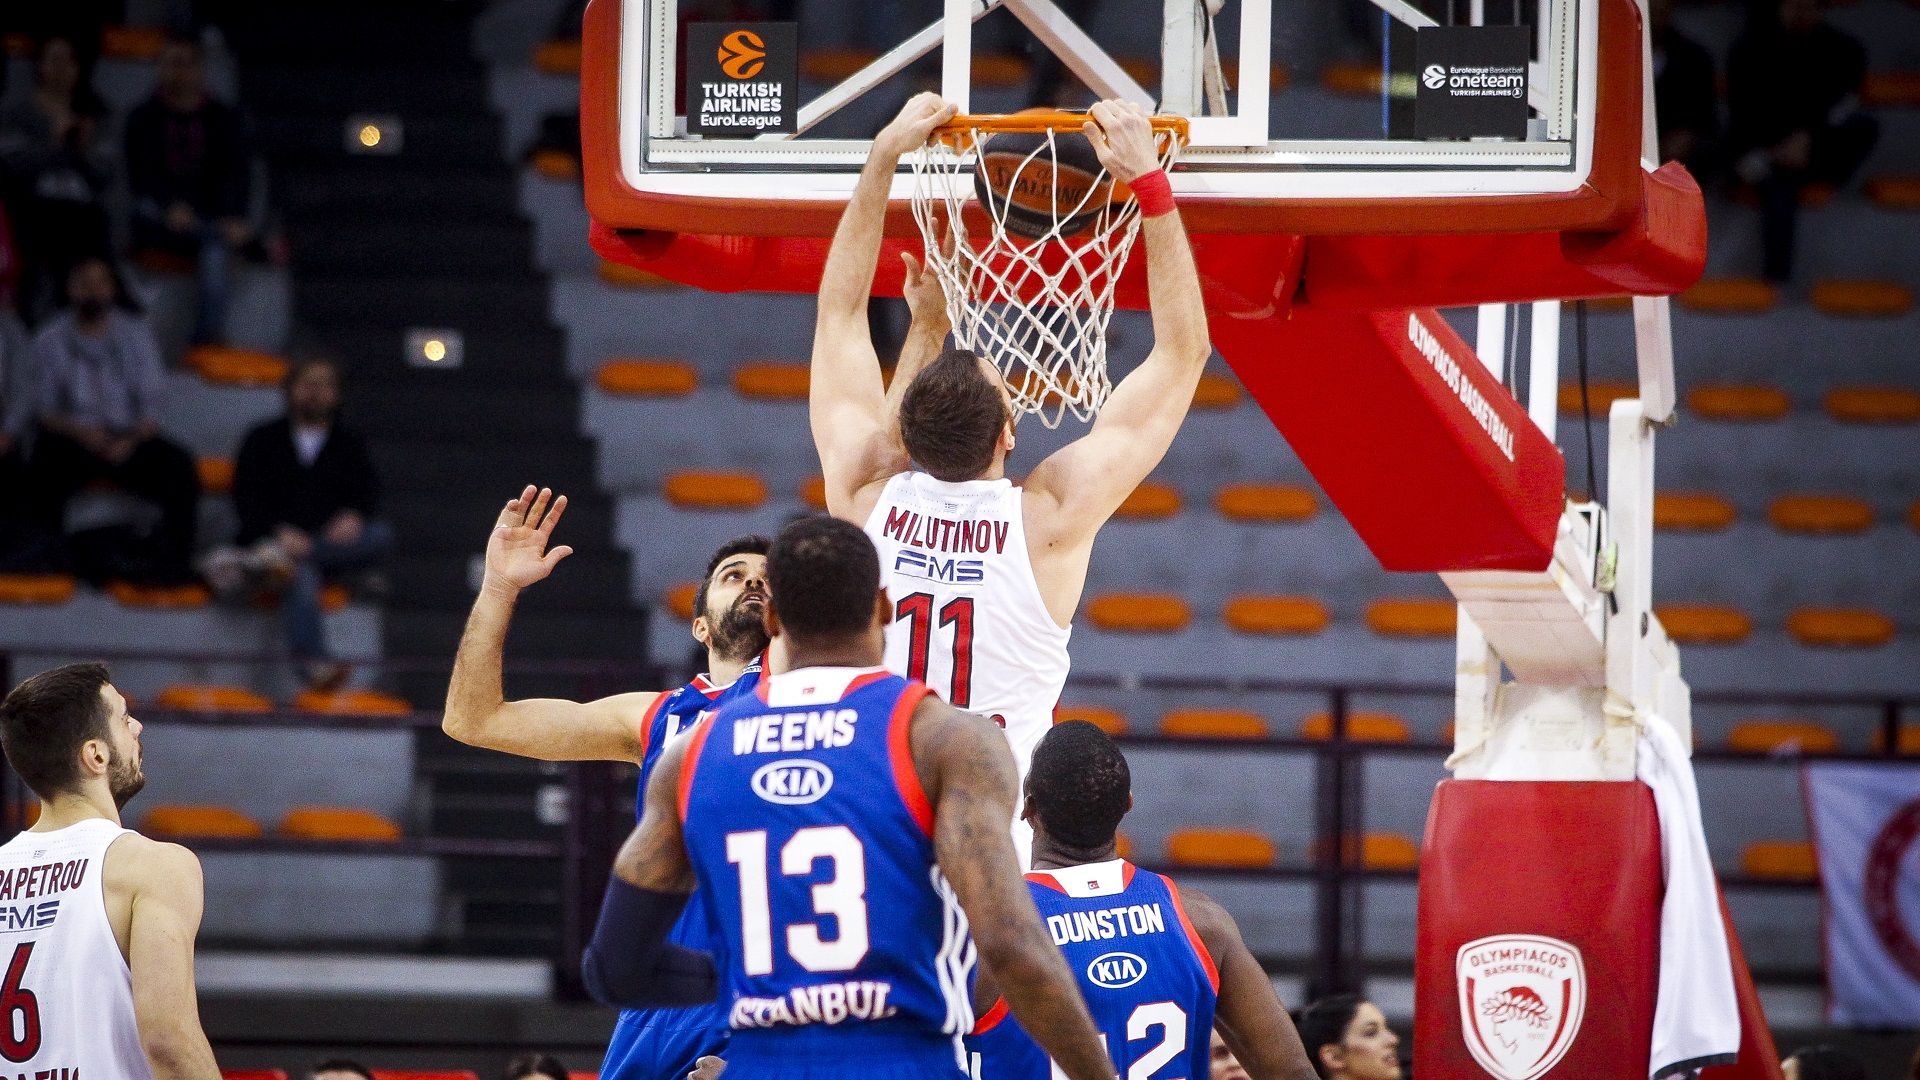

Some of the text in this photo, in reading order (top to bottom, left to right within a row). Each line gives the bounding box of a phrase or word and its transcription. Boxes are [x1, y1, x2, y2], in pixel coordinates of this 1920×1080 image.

[1449, 74, 1524, 88] oneteam
[1450, 66, 1524, 75] Euroleague Basketball
[702, 83, 782, 98] TURKISH
[701, 98, 782, 113] AIRLINES
[701, 114, 782, 130] EuroLeague
[1408, 312, 1515, 463] OLYMPIACOS BASKETBALL
[883, 505, 1010, 555] MILUTINOV
[894, 549, 984, 582] FMS
[896, 592, 974, 709] 11
[732, 709, 858, 756] WEEMS
[764, 767, 825, 798] KIA
[726, 825, 869, 976] 13
[1047, 903, 1165, 945] DUNSTON
[1095, 957, 1140, 984] KIA
[1470, 948, 1569, 968] OLYMPIACOS
[1483, 965, 1555, 979] BASKETBALL
